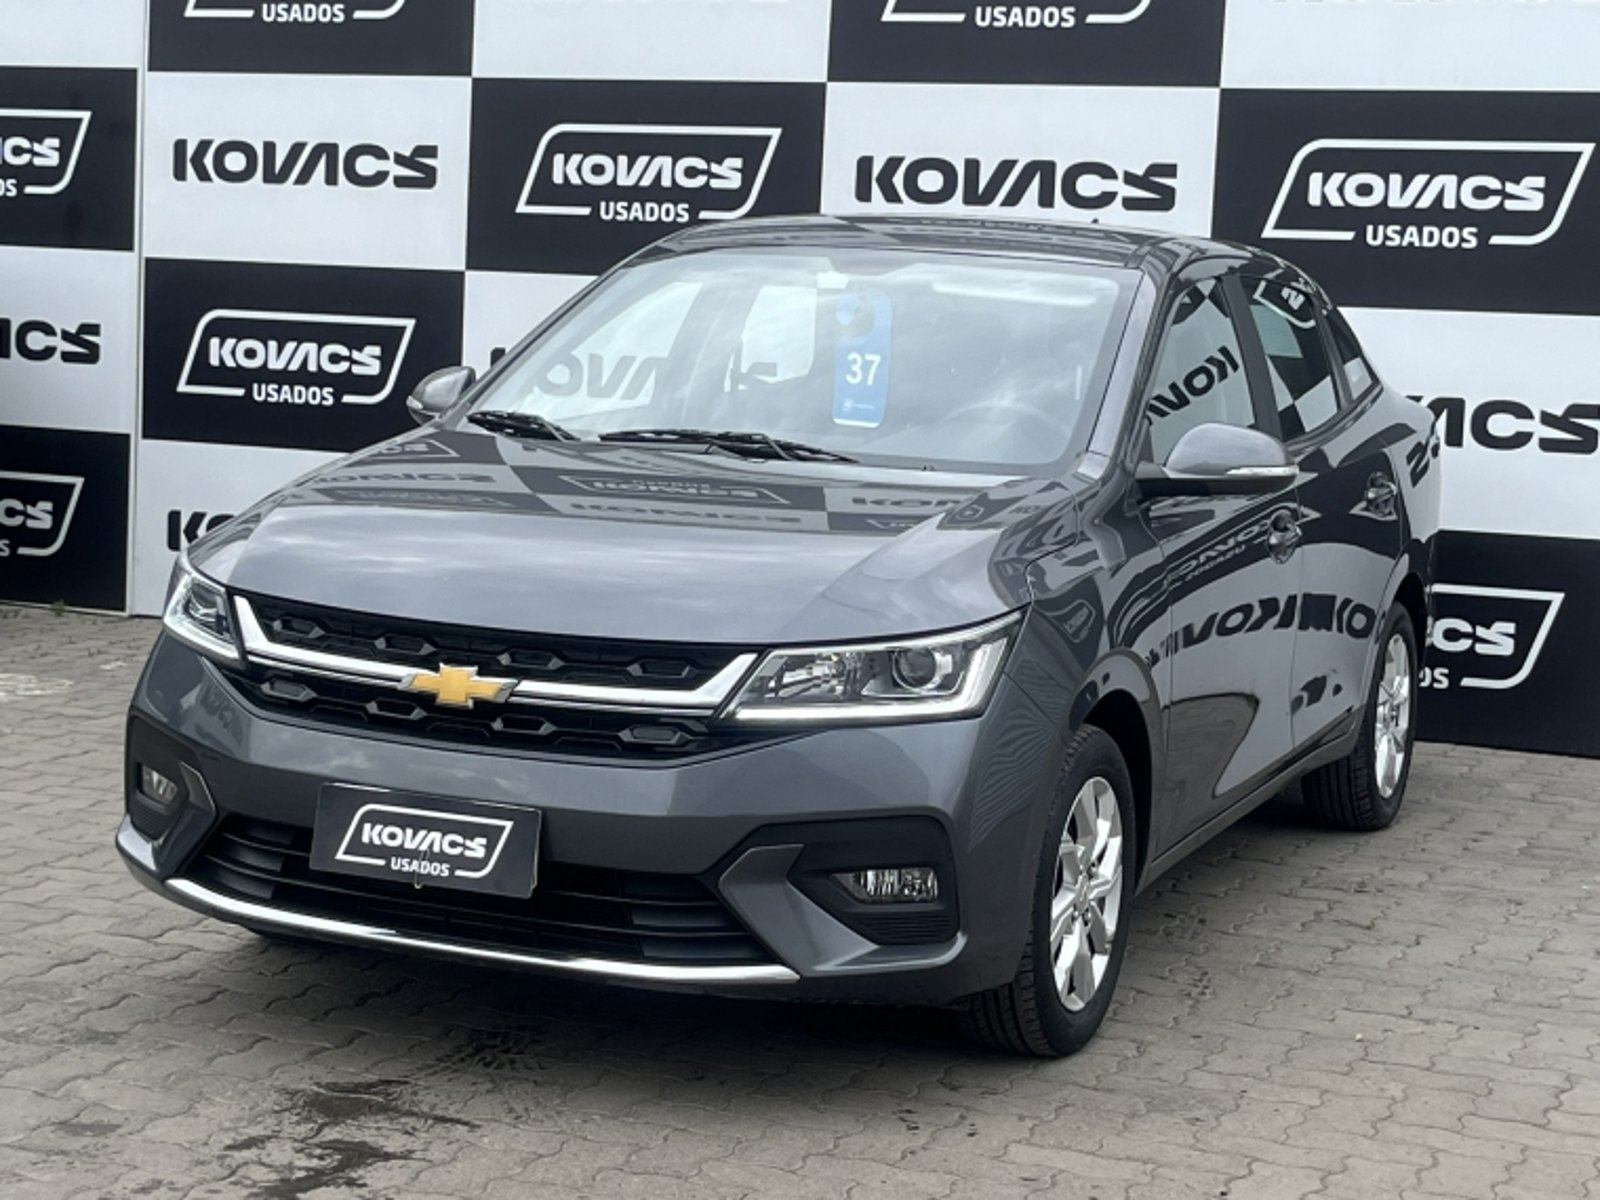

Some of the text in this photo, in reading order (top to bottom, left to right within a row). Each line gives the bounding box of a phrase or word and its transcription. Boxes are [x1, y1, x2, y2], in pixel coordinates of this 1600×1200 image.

[262, 3, 345, 23] USADOS
[975, 6, 1076, 28] USADOS
[0, 136, 60, 167] CS
[172, 138, 439, 190] KOVACS
[552, 153, 743, 191] KOVACS
[854, 154, 1178, 212] KOVACS
[1306, 171, 1547, 212] KOVACS
[599, 201, 691, 224] USADOS
[1365, 224, 1479, 249] USADOS
[0, 317, 101, 365] CS
[208, 336, 382, 376] KOVACS
[845, 351, 882, 386] 37
[252, 382, 334, 406] USADOS
[1405, 395, 1600, 455] ACS
[361, 822, 488, 859] KOVACS
[390, 855, 451, 878] USADOS
